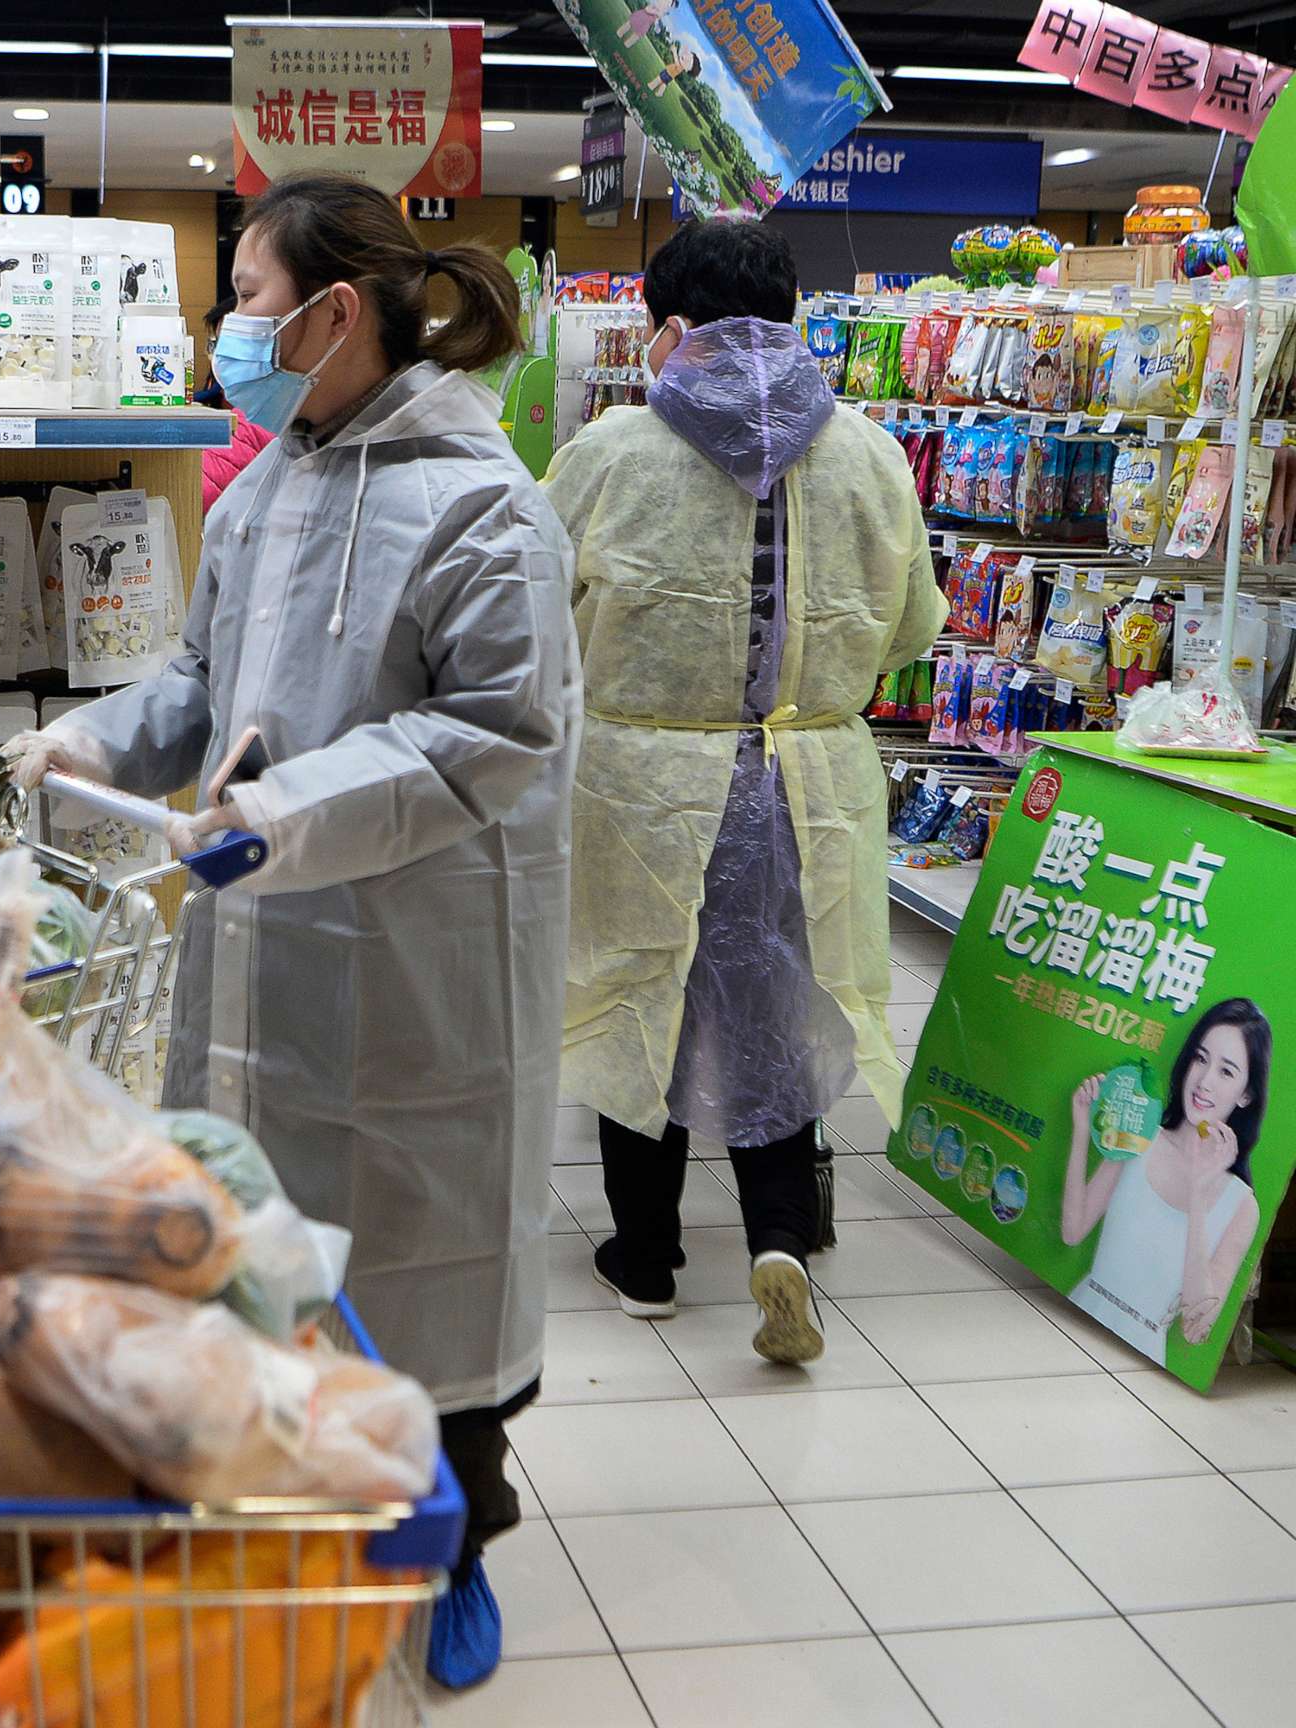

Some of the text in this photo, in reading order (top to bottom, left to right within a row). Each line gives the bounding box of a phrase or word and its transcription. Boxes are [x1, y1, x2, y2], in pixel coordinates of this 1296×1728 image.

[254, 87, 427, 146] 诚信是福
[3, 183, 41, 214] 09
[418, 197, 448, 219] 11
[788, 180, 850, 203] 收银区
[1032, 809, 1228, 930] 酸一点
[989, 883, 1218, 1014] 吃溜溜梅
[994, 972, 1168, 1055] 一年热销20亿颗
